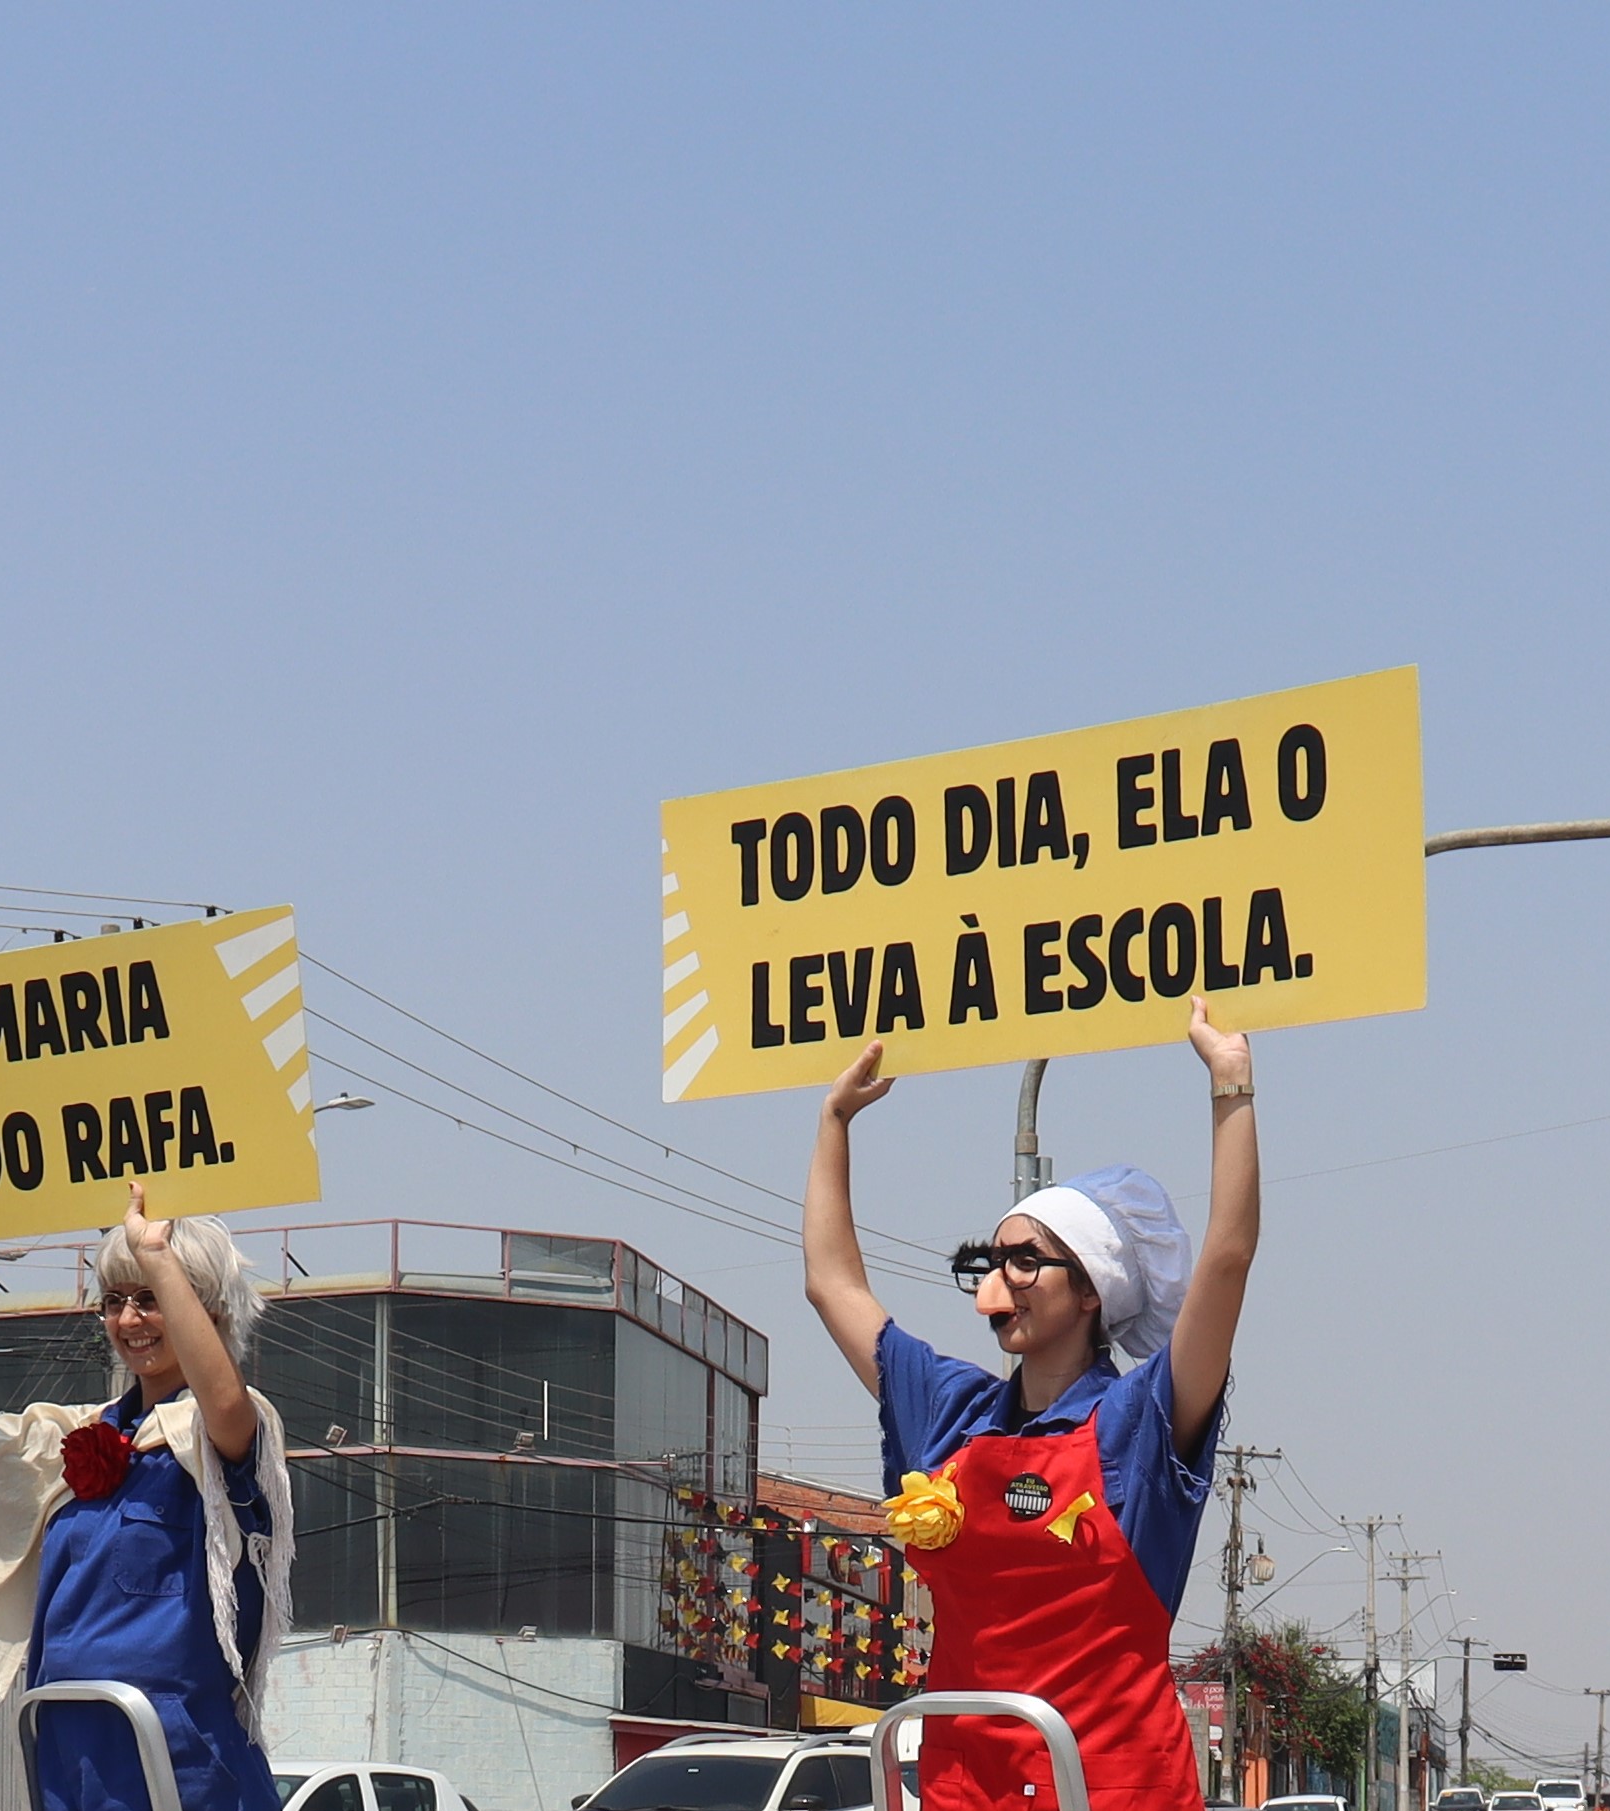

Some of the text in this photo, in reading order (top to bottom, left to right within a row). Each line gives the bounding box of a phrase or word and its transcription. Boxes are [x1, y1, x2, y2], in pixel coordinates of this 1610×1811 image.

[731, 722, 1328, 907] TODO DIA, ELA O
[751, 886, 1314, 1050] LEVA À ESCOLA.
[61, 1084, 236, 1184] RAFA.
